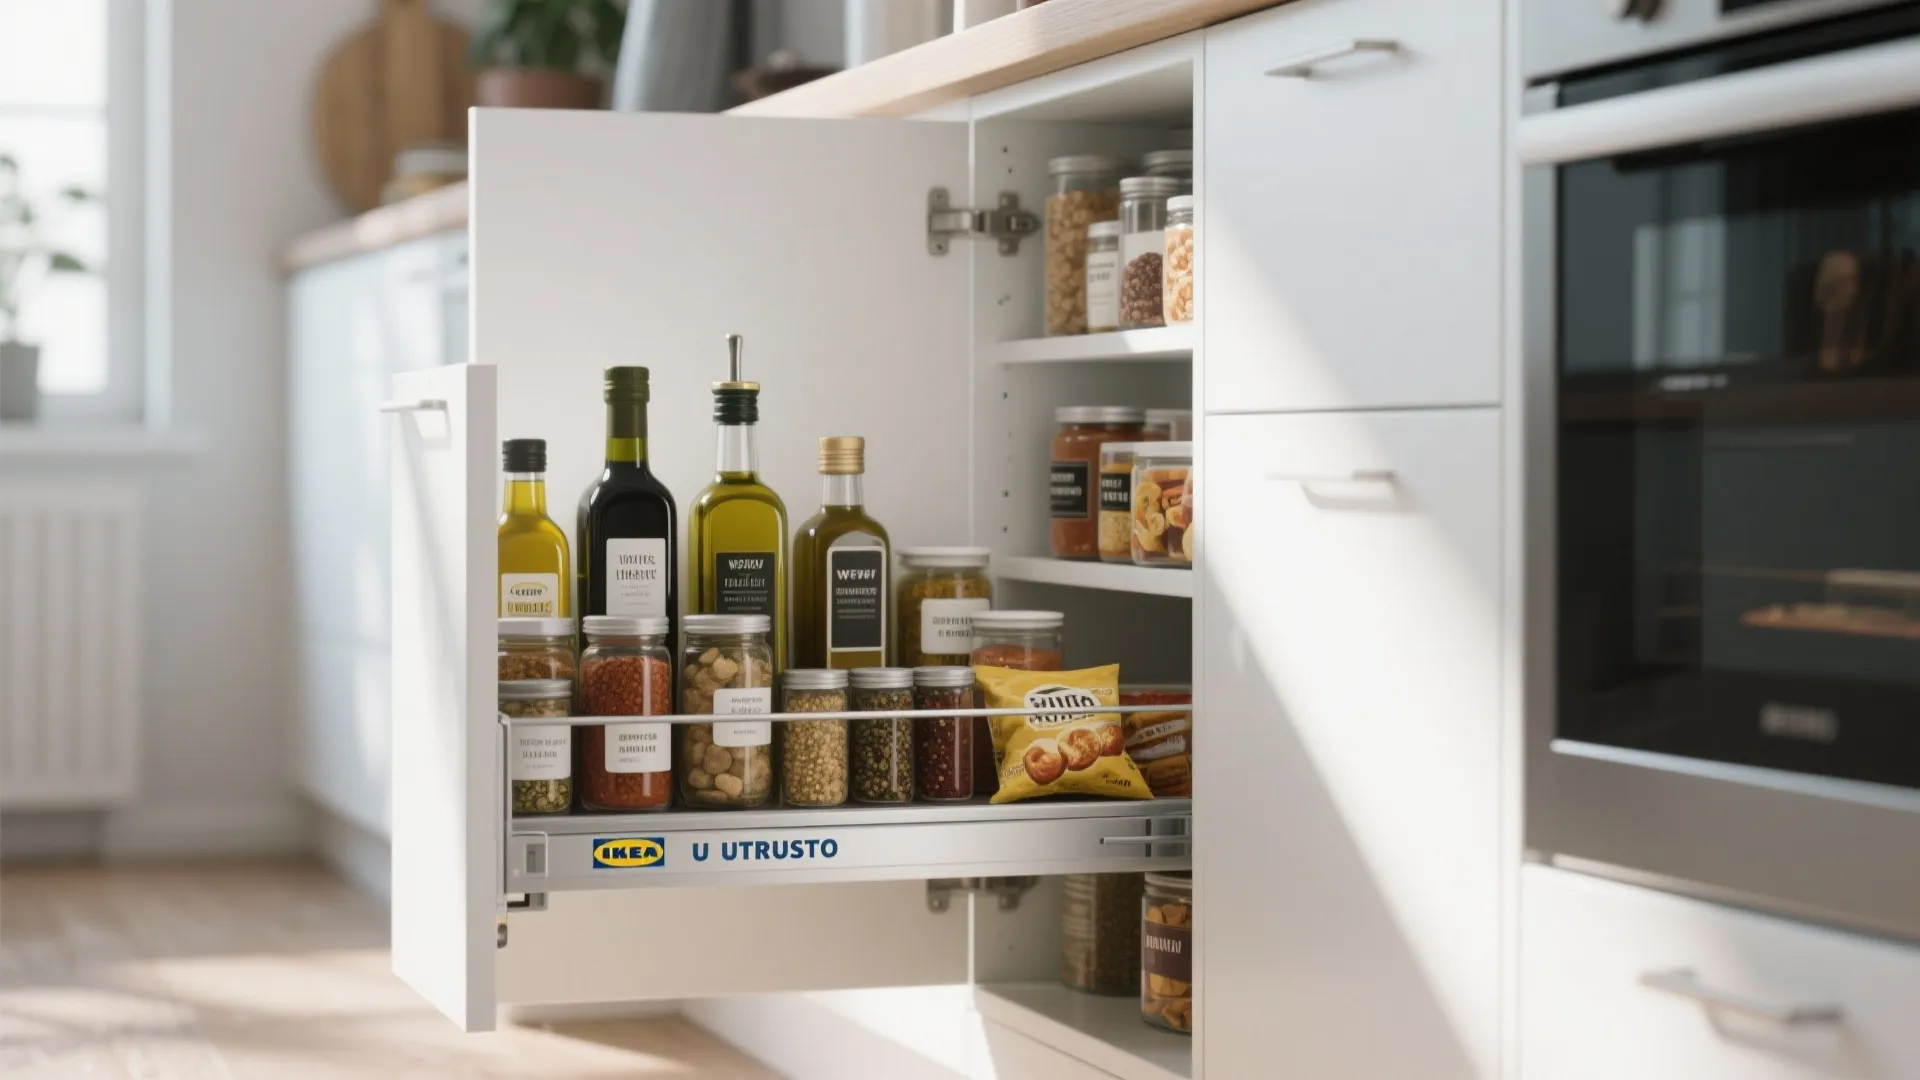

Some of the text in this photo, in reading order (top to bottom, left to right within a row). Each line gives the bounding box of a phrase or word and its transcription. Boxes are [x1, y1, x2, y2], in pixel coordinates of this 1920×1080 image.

[602, 838, 839, 861] IKEA U UTRUSTO
